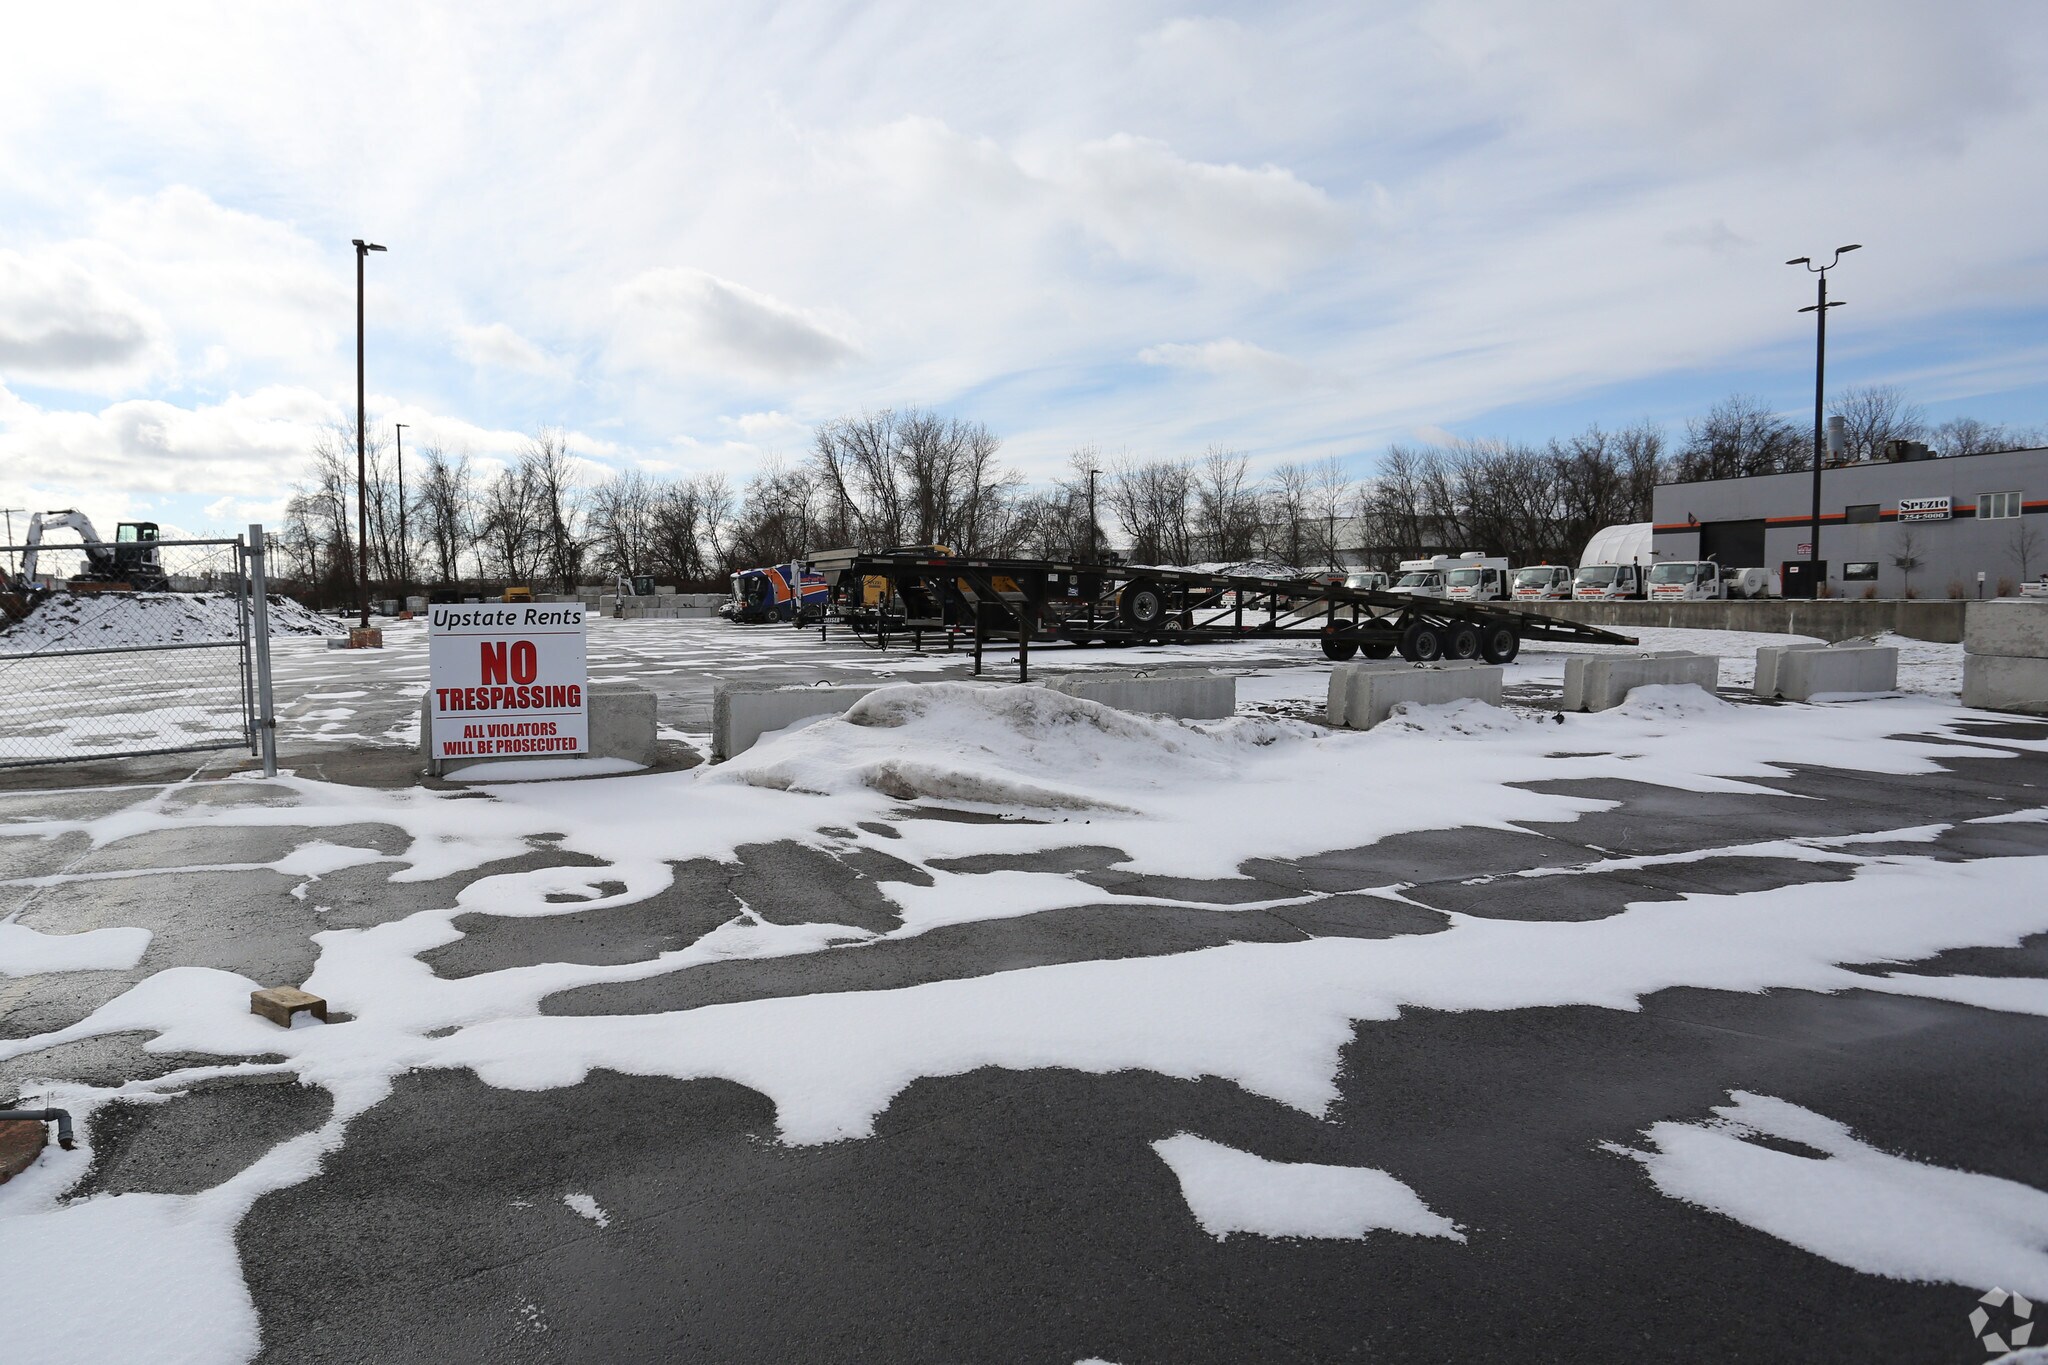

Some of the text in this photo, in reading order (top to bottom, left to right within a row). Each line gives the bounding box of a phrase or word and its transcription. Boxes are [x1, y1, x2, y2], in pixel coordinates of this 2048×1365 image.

[1900, 500, 1948, 511] SPEZIO
[1904, 512, 1945, 520] 254-5000
[433, 608, 581, 631] Upstate Rents
[480, 640, 537, 685] NO
[436, 685, 581, 711] TRESPASSING
[463, 722, 557, 739] ALL VIOLATORS
[443, 737, 577, 756] WILL BE PROSECUTED
